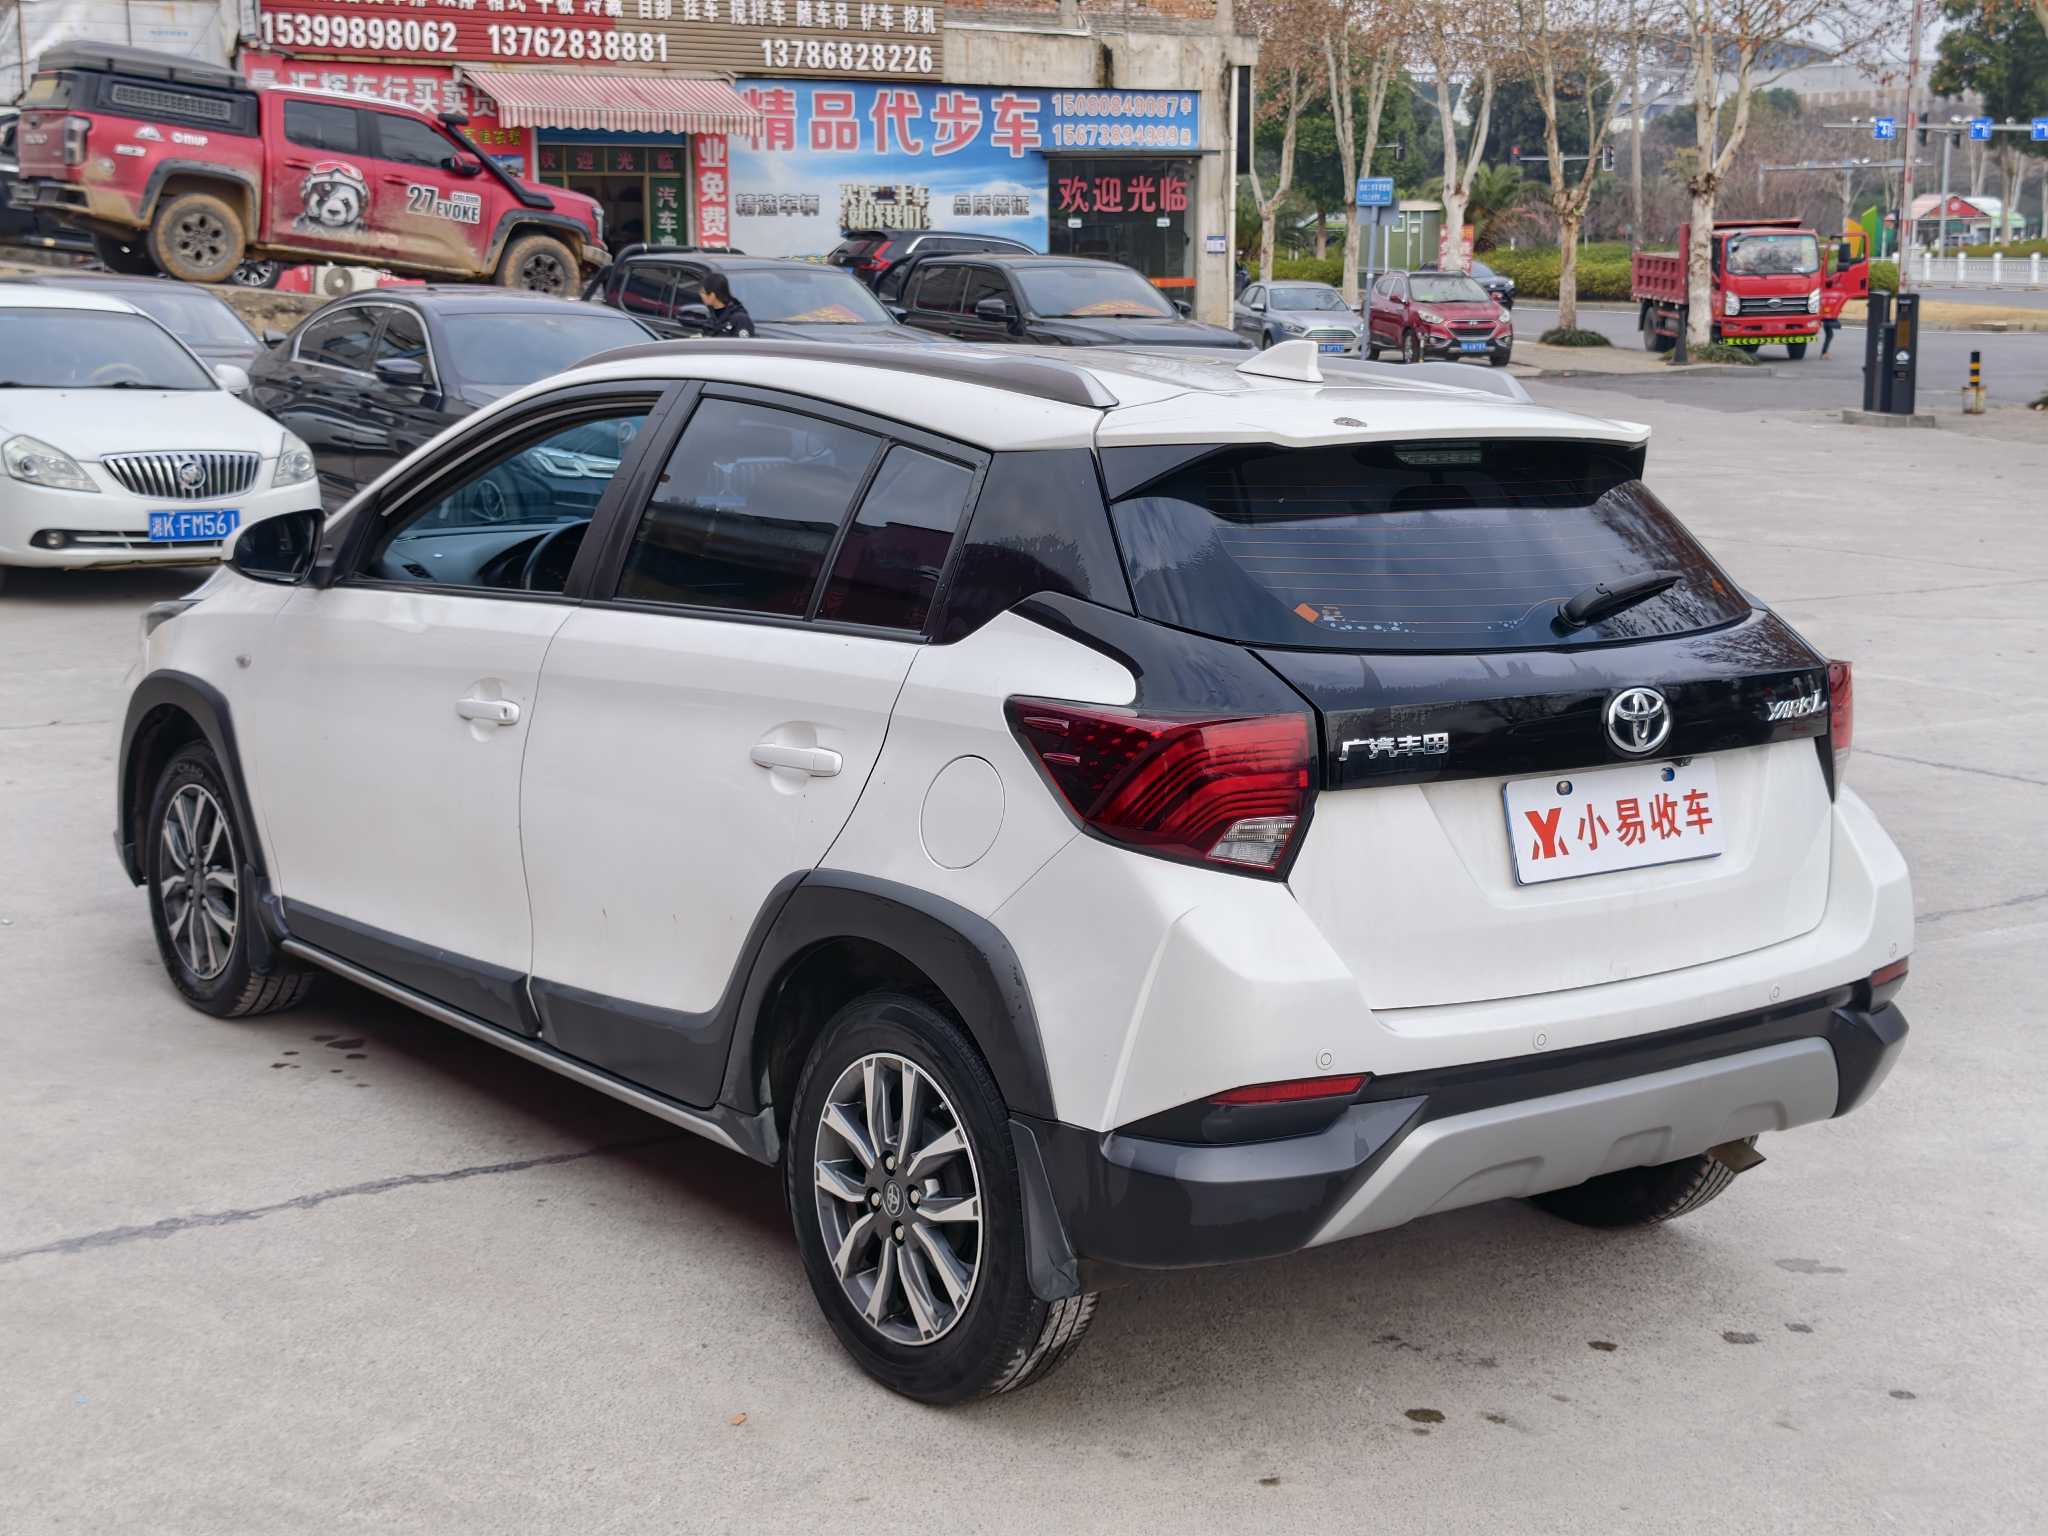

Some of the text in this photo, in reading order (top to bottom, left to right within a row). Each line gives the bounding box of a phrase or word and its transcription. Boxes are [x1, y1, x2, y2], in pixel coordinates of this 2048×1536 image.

[261, 12, 458, 53] 15399898062
[487, 24, 668, 62] 13762838881
[761, 39, 933, 73] 13786828226
[407, 185, 438, 215] 27
[436, 201, 479, 222] EVOKE
[1057, 175, 1189, 213] 欢迎光临
[1338, 732, 1449, 762] 广汽丰田
[1577, 789, 1713, 851] 小易收车
